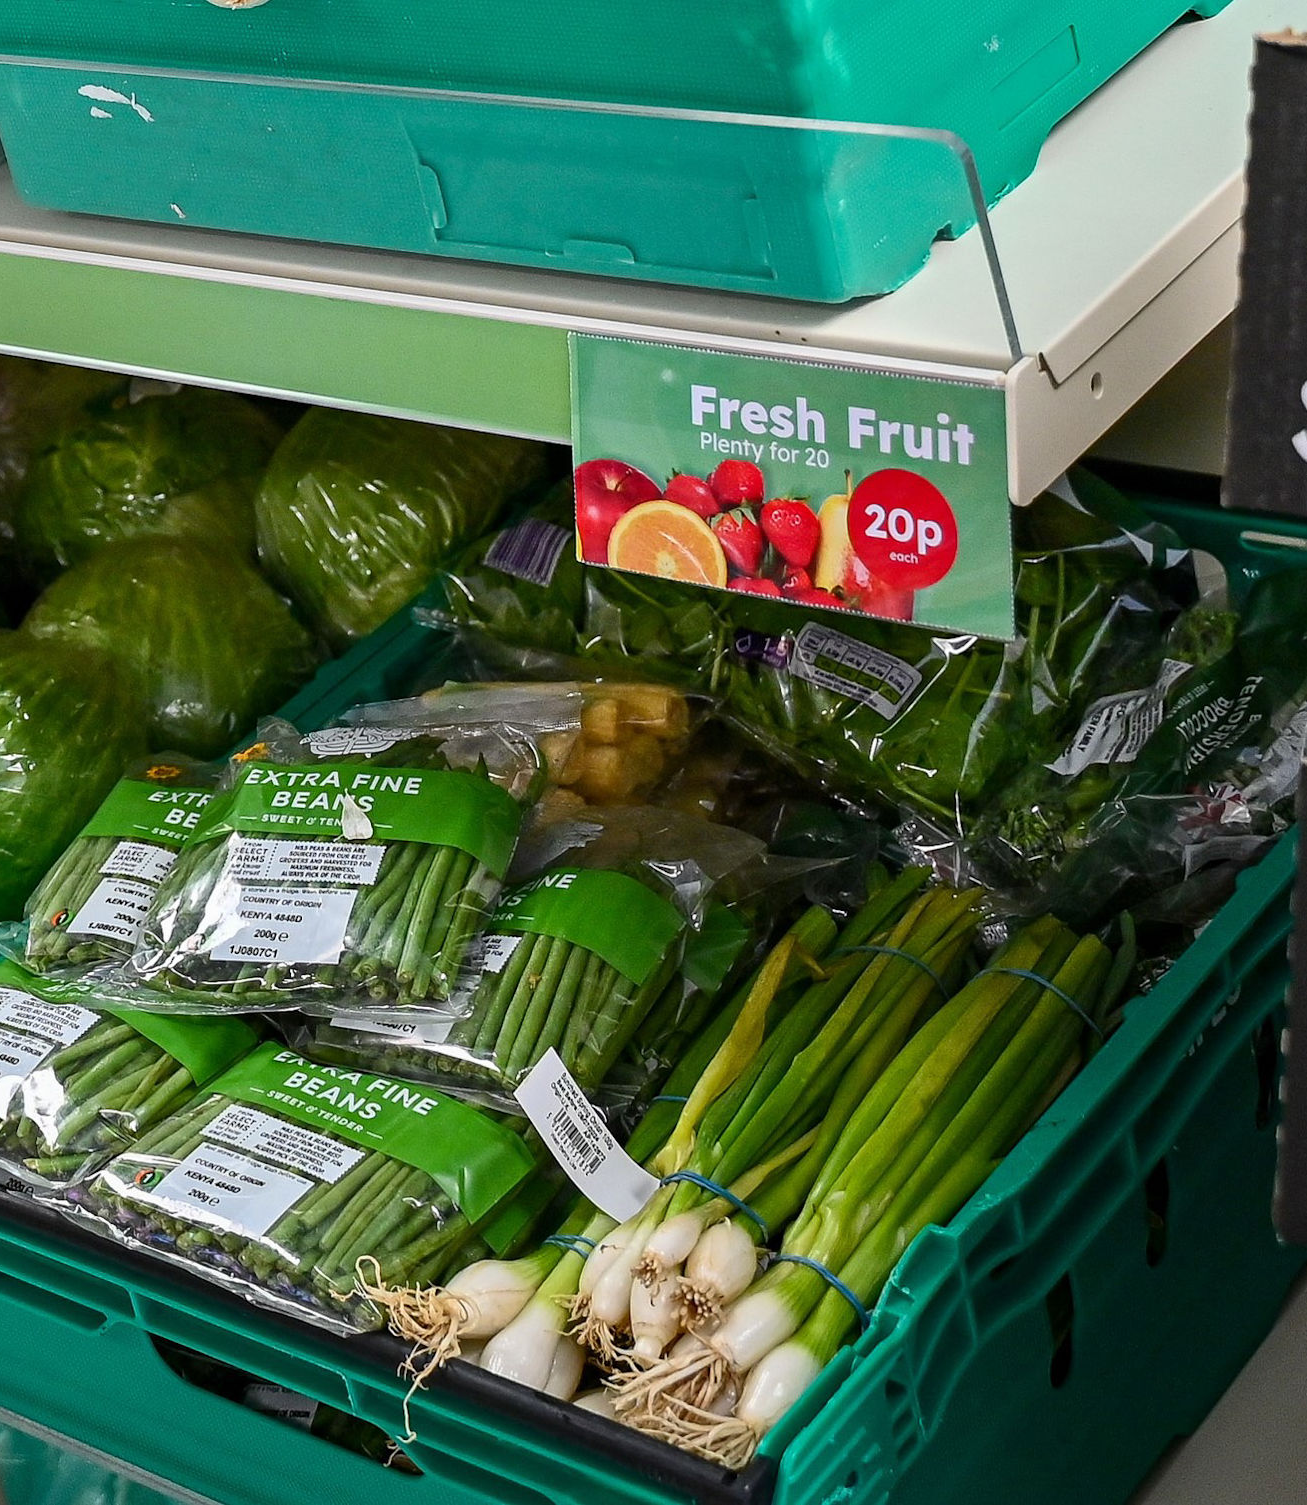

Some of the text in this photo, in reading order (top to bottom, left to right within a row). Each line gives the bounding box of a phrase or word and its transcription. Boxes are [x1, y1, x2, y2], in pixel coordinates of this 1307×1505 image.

[691, 384, 974, 466] Fresh Fruit
[700, 431, 830, 469] Plenty for 20
[864, 503, 942, 556] 20p
[889, 550, 918, 565] each
[1176, 696, 1234, 741] BROCCOLI
[244, 769, 423, 795] EXTRA FINE
[271, 792, 375, 813] BEANS
[261, 813, 318, 826] SWEET &
[114, 855, 143, 863] FARMS
[114, 887, 149, 899] COUNTRY
[105, 898, 135, 908] KENYA
[243, 896, 322, 908] COUNTRY OF ORIGIN
[114, 913, 135, 924] 200g
[240, 910, 302, 923] KENYA 4848D
[88, 922, 133, 936] 1J0807C1
[254, 929, 277, 941] 200g
[229, 945, 278, 958] 1J0807C1
[12, 1041, 20, 1049] OF
[21, 1045, 43, 1057] ORIGIN
[283, 1072, 381, 1119] BEANS
[366, 1078, 438, 1116] FINE
[267, 1090, 306, 1109] SWEET
[318, 1109, 363, 1132] TENDER
[561, 1072, 614, 1151] Bunched Spring Onion 100g
[219, 1117, 250, 1132] FARMS
[225, 1112, 257, 1126] SELECT
[260, 1132, 343, 1168] GROWERS AND HARVESTED FOR
[266, 1140, 292, 1152] MAXIMUM
[272, 1129, 341, 1159] SOURCED FROM OUR BEST
[313, 1138, 332, 1149] BEANS
[333, 1145, 344, 1153] ARE
[254, 1144, 277, 1155] ALWAYS
[277, 1152, 290, 1161] PICK
[298, 1159, 309, 1168] THE
[184, 1170, 215, 1186] KENYA
[195, 1157, 267, 1187] COUNTRY OF ORIGIN
[188, 1188, 210, 1203] 200g
